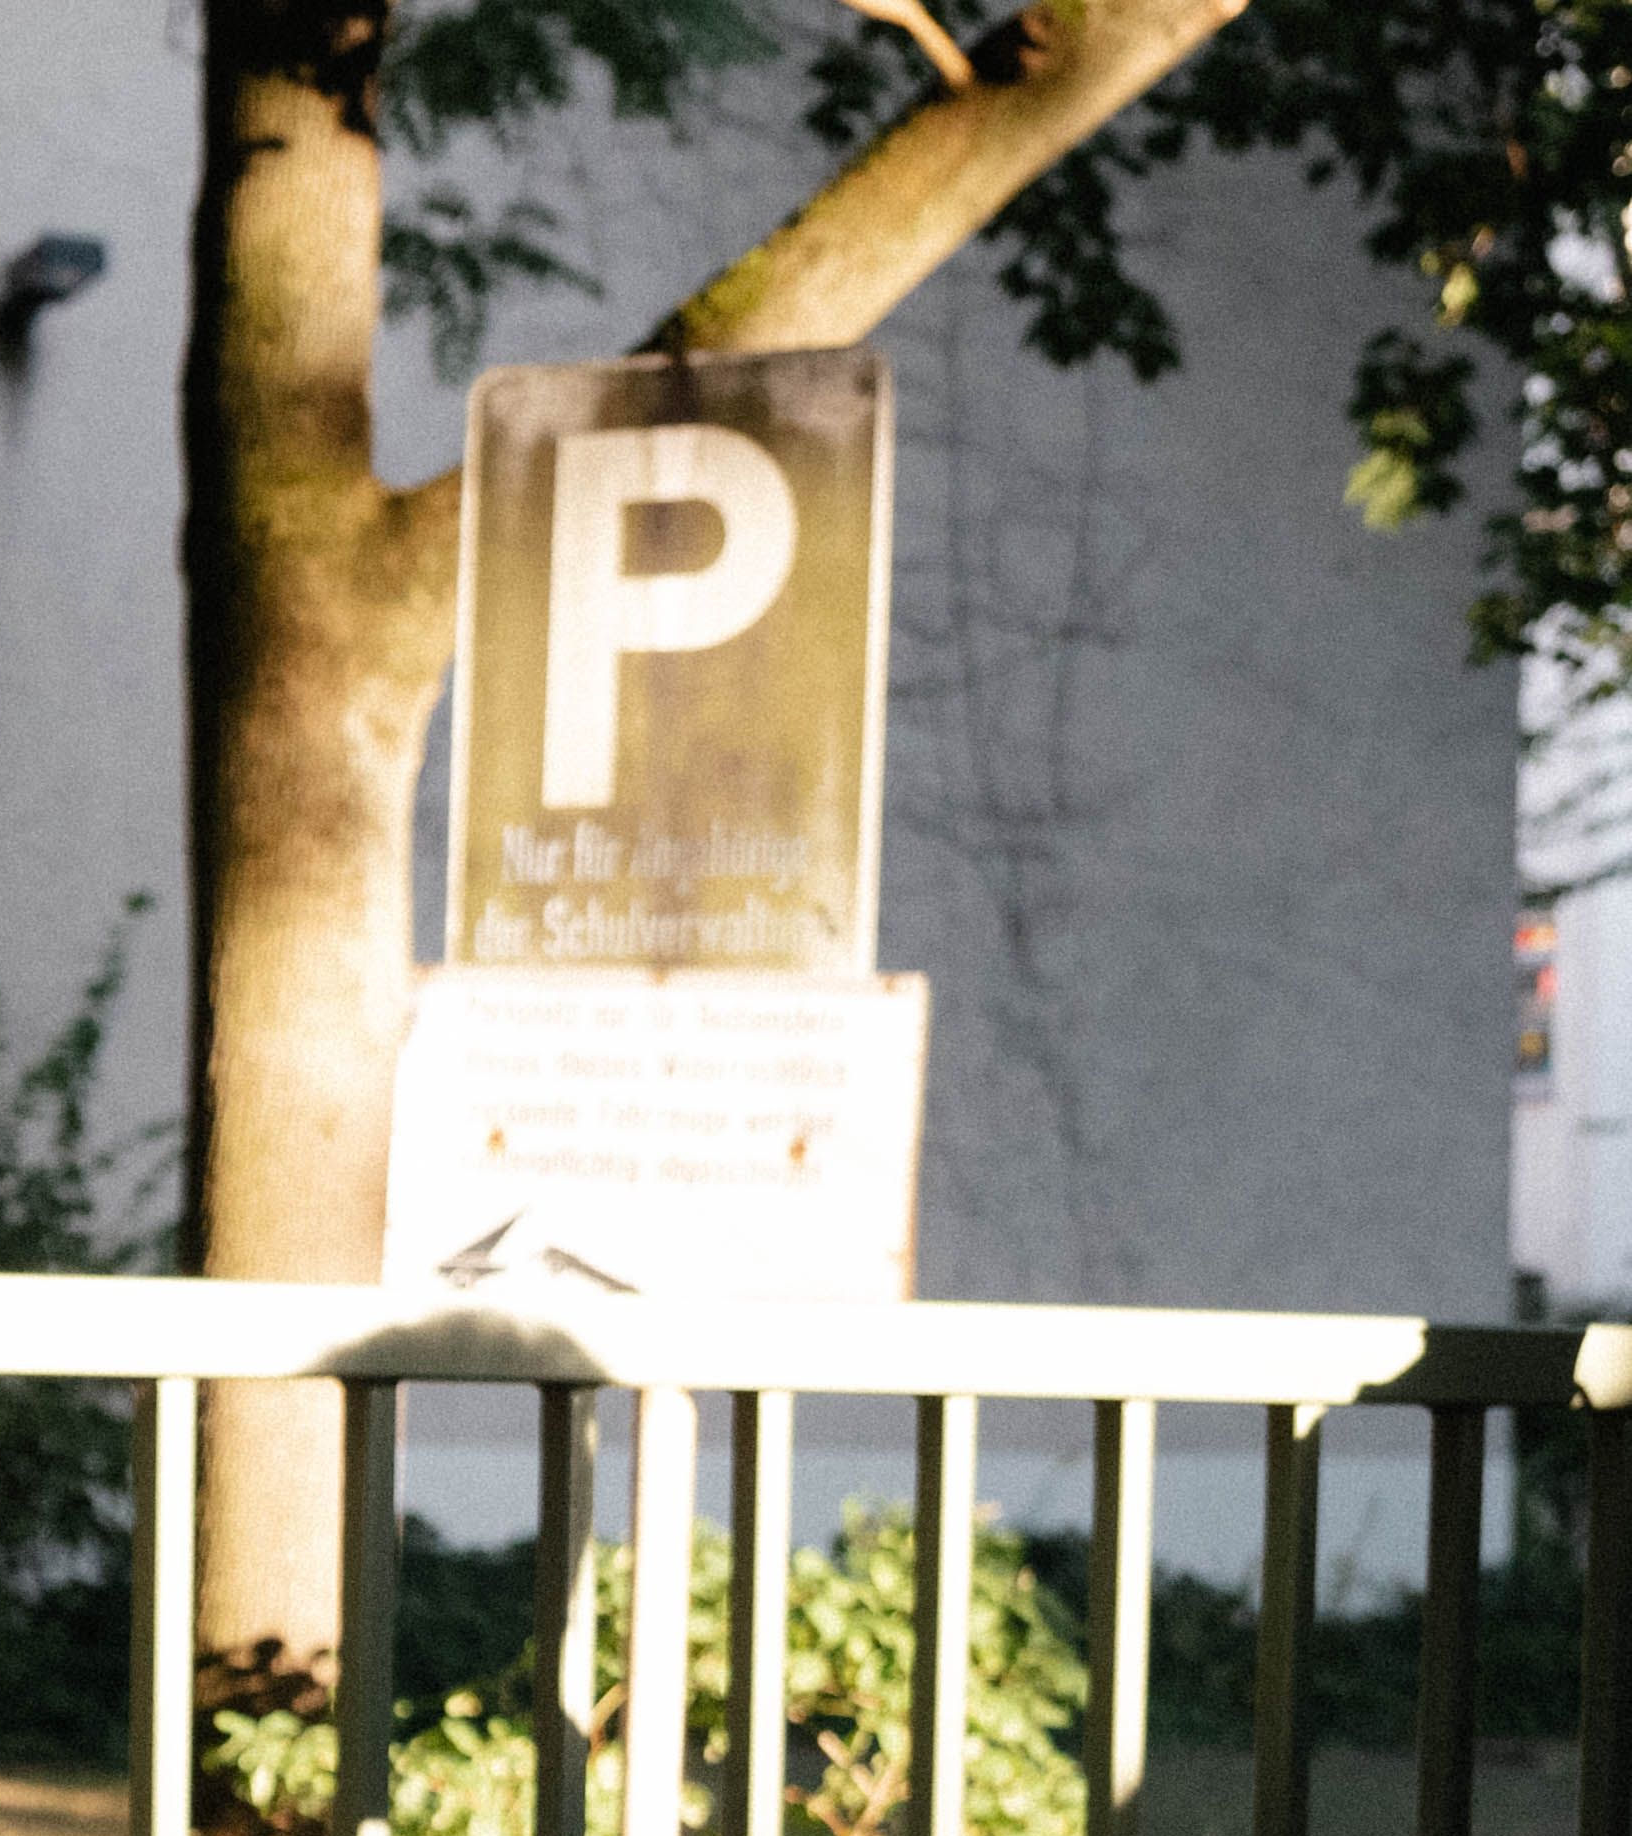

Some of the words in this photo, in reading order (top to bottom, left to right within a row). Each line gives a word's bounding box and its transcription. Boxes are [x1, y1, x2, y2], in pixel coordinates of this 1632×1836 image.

[542, 423, 799, 809] P
[501, 821, 566, 883] Nur
[573, 817, 625, 881] für
[474, 896, 533, 958] der
